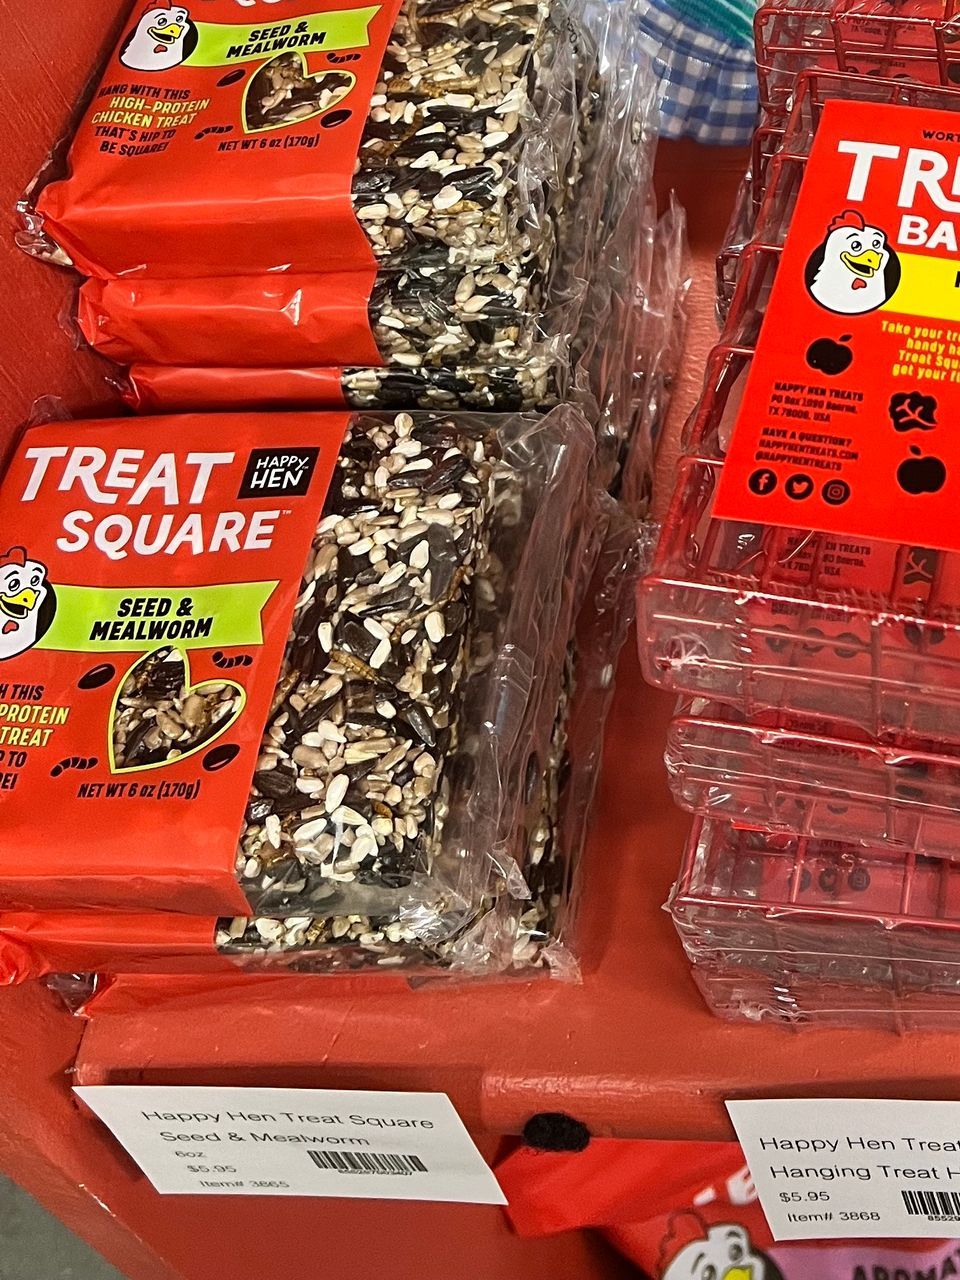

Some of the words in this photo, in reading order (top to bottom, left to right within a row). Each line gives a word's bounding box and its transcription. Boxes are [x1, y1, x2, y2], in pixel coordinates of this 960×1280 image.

[249, 24, 291, 43] SEED
[293, 21, 309, 34] &
[226, 31, 327, 59] MEALWORM
[98, 83, 128, 99] HANG
[129, 84, 162, 98] WITH
[164, 87, 191, 100] THIS
[109, 96, 210, 114] HIGH-PROTEIN
[92, 111, 153, 128] CHICKEN
[156, 112, 197, 128] TREAT
[95, 125, 137, 141] THAT'S
[140, 130, 160, 143] HIP
[161, 128, 176, 139] TO
[217, 140, 238, 152] NET
[240, 138, 259, 150] WT
[260, 137, 267, 149] 6
[269, 138, 282, 148] oz
[283, 133, 320, 150] (170g)
[100, 141, 117, 153] BE
[119, 141, 170, 157] SQUARE!
[881, 320, 911, 336] Take
[914, 326, 942, 340] your
[906, 338, 945, 355] handy
[20, 446, 236, 507] TREAT
[117, 597, 172, 618] SEED
[176, 597, 193, 617] &
[89, 617, 213, 642] MEALWORM
[11, 683, 45, 701] THIS
[0, 728, 54, 748] TREAT
[8, 751, 27, 768] TO
[77, 782, 104, 798] NET
[105, 782, 127, 798] WT
[128, 782, 138, 796] 6
[139, 784, 154, 798] oz
[156, 778, 201, 800] (170g)
[141, 1108, 221, 1126] Happy
[225, 1109, 278, 1124] Hen
[280, 1111, 344, 1127] Treat
[348, 1112, 435, 1131] Square
[159, 1129, 222, 1144] Seed
[227, 1131, 247, 1143] &
[250, 1131, 371, 1147] Mealworm
[759, 1135, 839, 1153] Happy
[846, 1135, 896, 1152] Hen
[187, 1163, 238, 1175] $5.95
[769, 1163, 871, 1182] Hanging
[877, 1164, 940, 1180] Treat
[779, 1190, 831, 1204] $5.95
[787, 1211, 833, 1223] Item#
[838, 1210, 881, 1222] 3868
